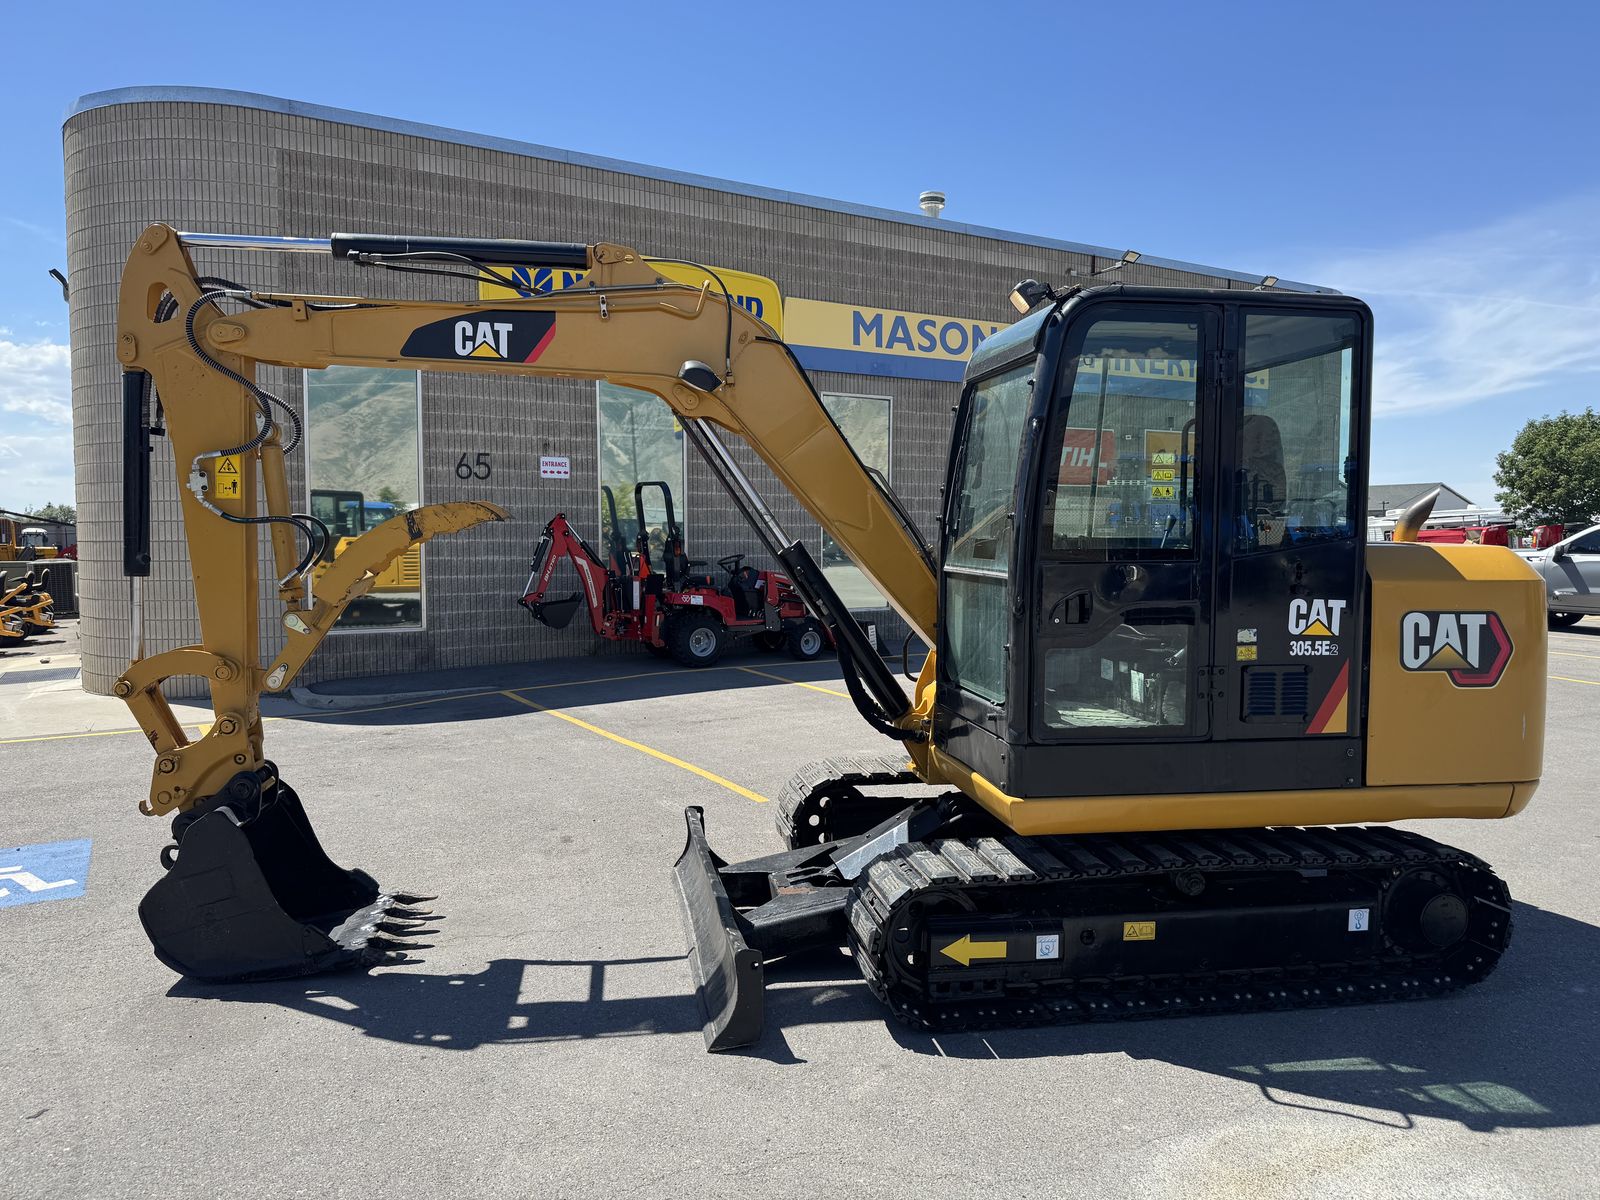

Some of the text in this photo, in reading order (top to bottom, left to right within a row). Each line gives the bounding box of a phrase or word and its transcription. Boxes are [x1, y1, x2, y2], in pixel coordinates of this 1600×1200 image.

[454, 320, 513, 358] CAT
[456, 452, 491, 480] 65
[541, 460, 568, 468] ENTRANCE
[1288, 598, 1347, 637] CAT
[1289, 640, 1339, 656] 305.5E2
[1402, 612, 1487, 669] CAT
